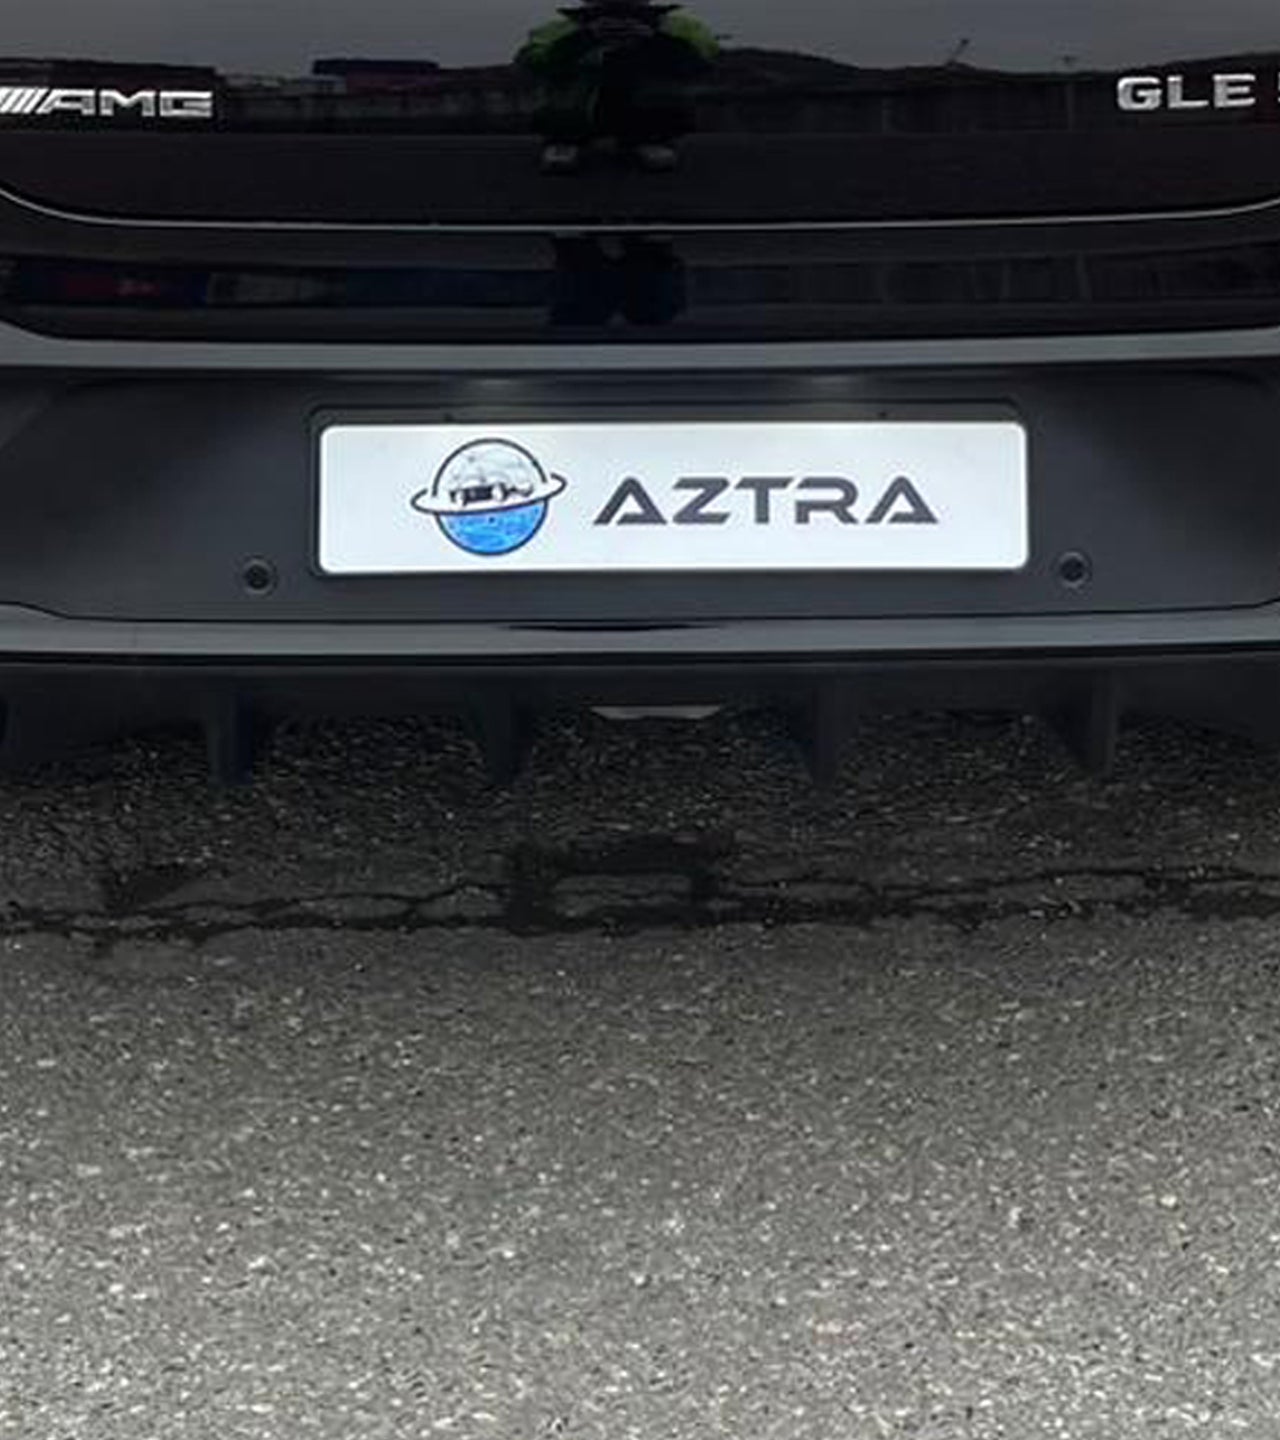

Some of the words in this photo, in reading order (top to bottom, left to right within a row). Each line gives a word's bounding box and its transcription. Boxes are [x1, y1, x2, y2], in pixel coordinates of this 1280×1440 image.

[36, 88, 213, 118] AMG
[1116, 72, 1257, 110] GLE
[592, 476, 939, 525] AZTRA
